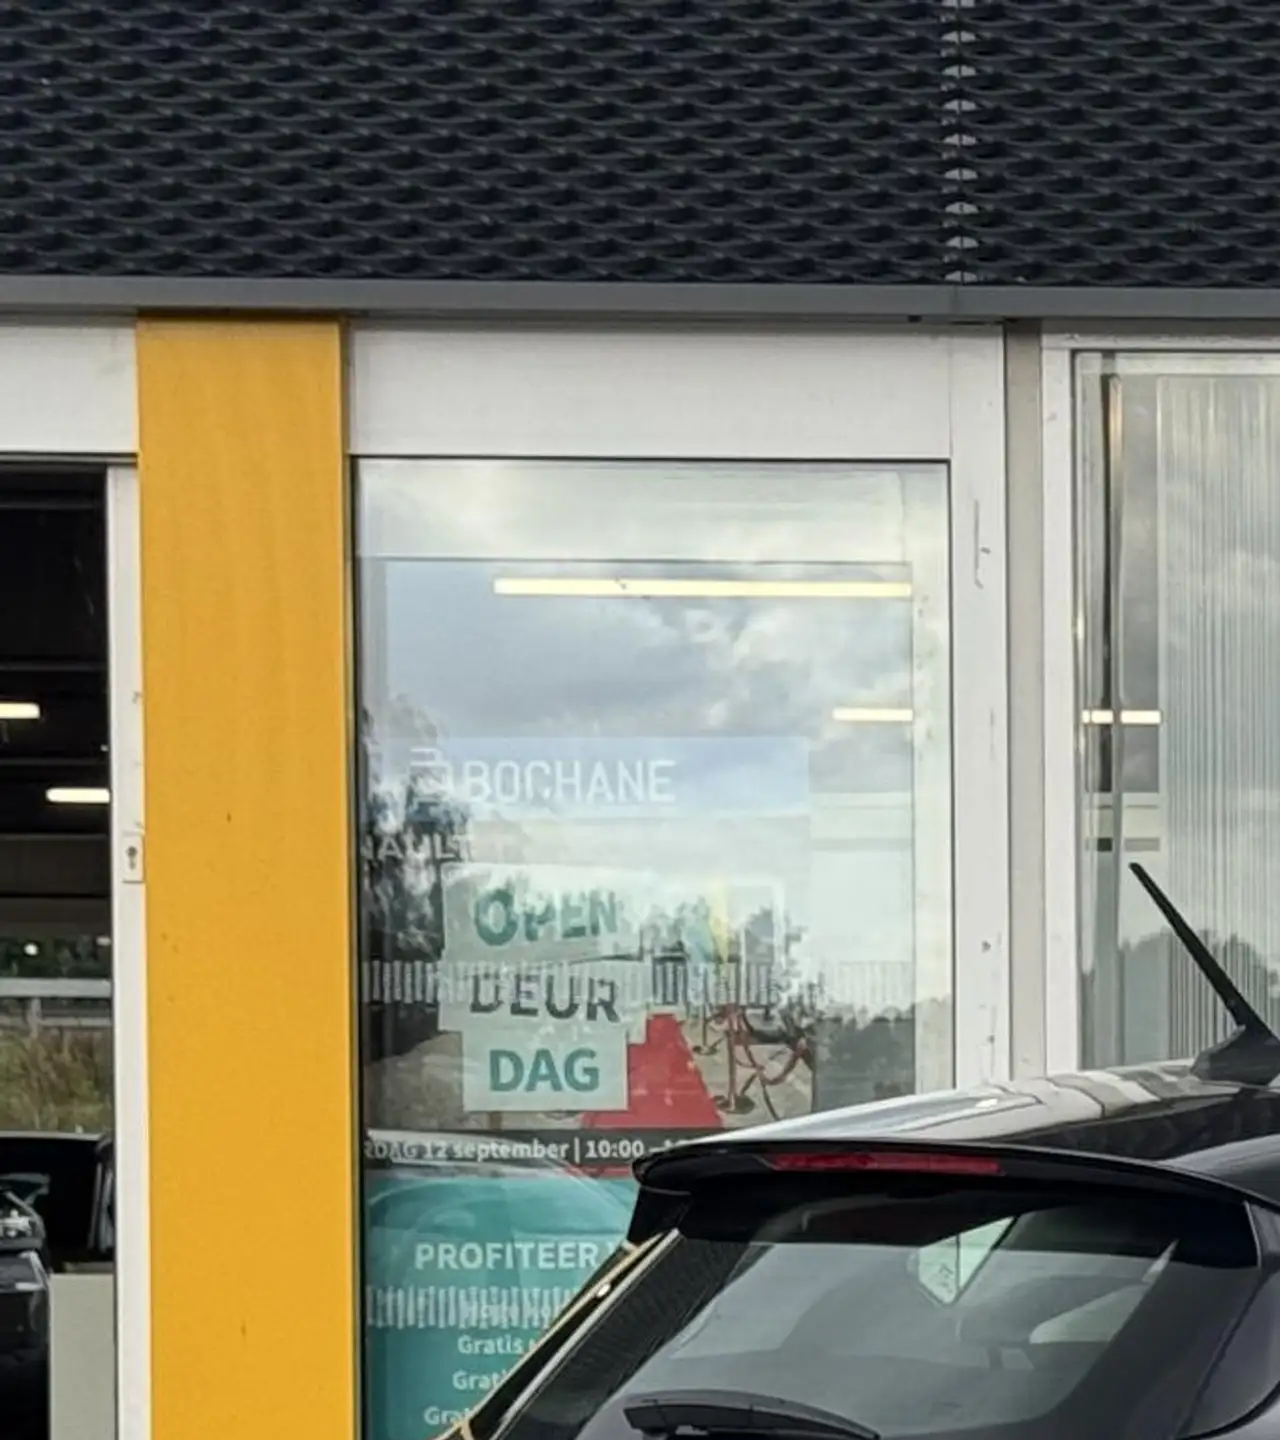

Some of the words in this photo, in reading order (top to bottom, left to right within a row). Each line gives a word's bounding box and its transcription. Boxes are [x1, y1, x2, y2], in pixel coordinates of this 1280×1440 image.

[463, 760, 677, 801] BOCHANE
[474, 887, 618, 946] OPEN
[469, 971, 621, 1022] DEUR
[489, 1048, 600, 1093] DAG
[453, 1139, 569, 1163] september
[585, 1139, 645, 1159] 10:00
[414, 1242, 600, 1270] PROFITEER
[457, 1333, 523, 1355] Gratis
